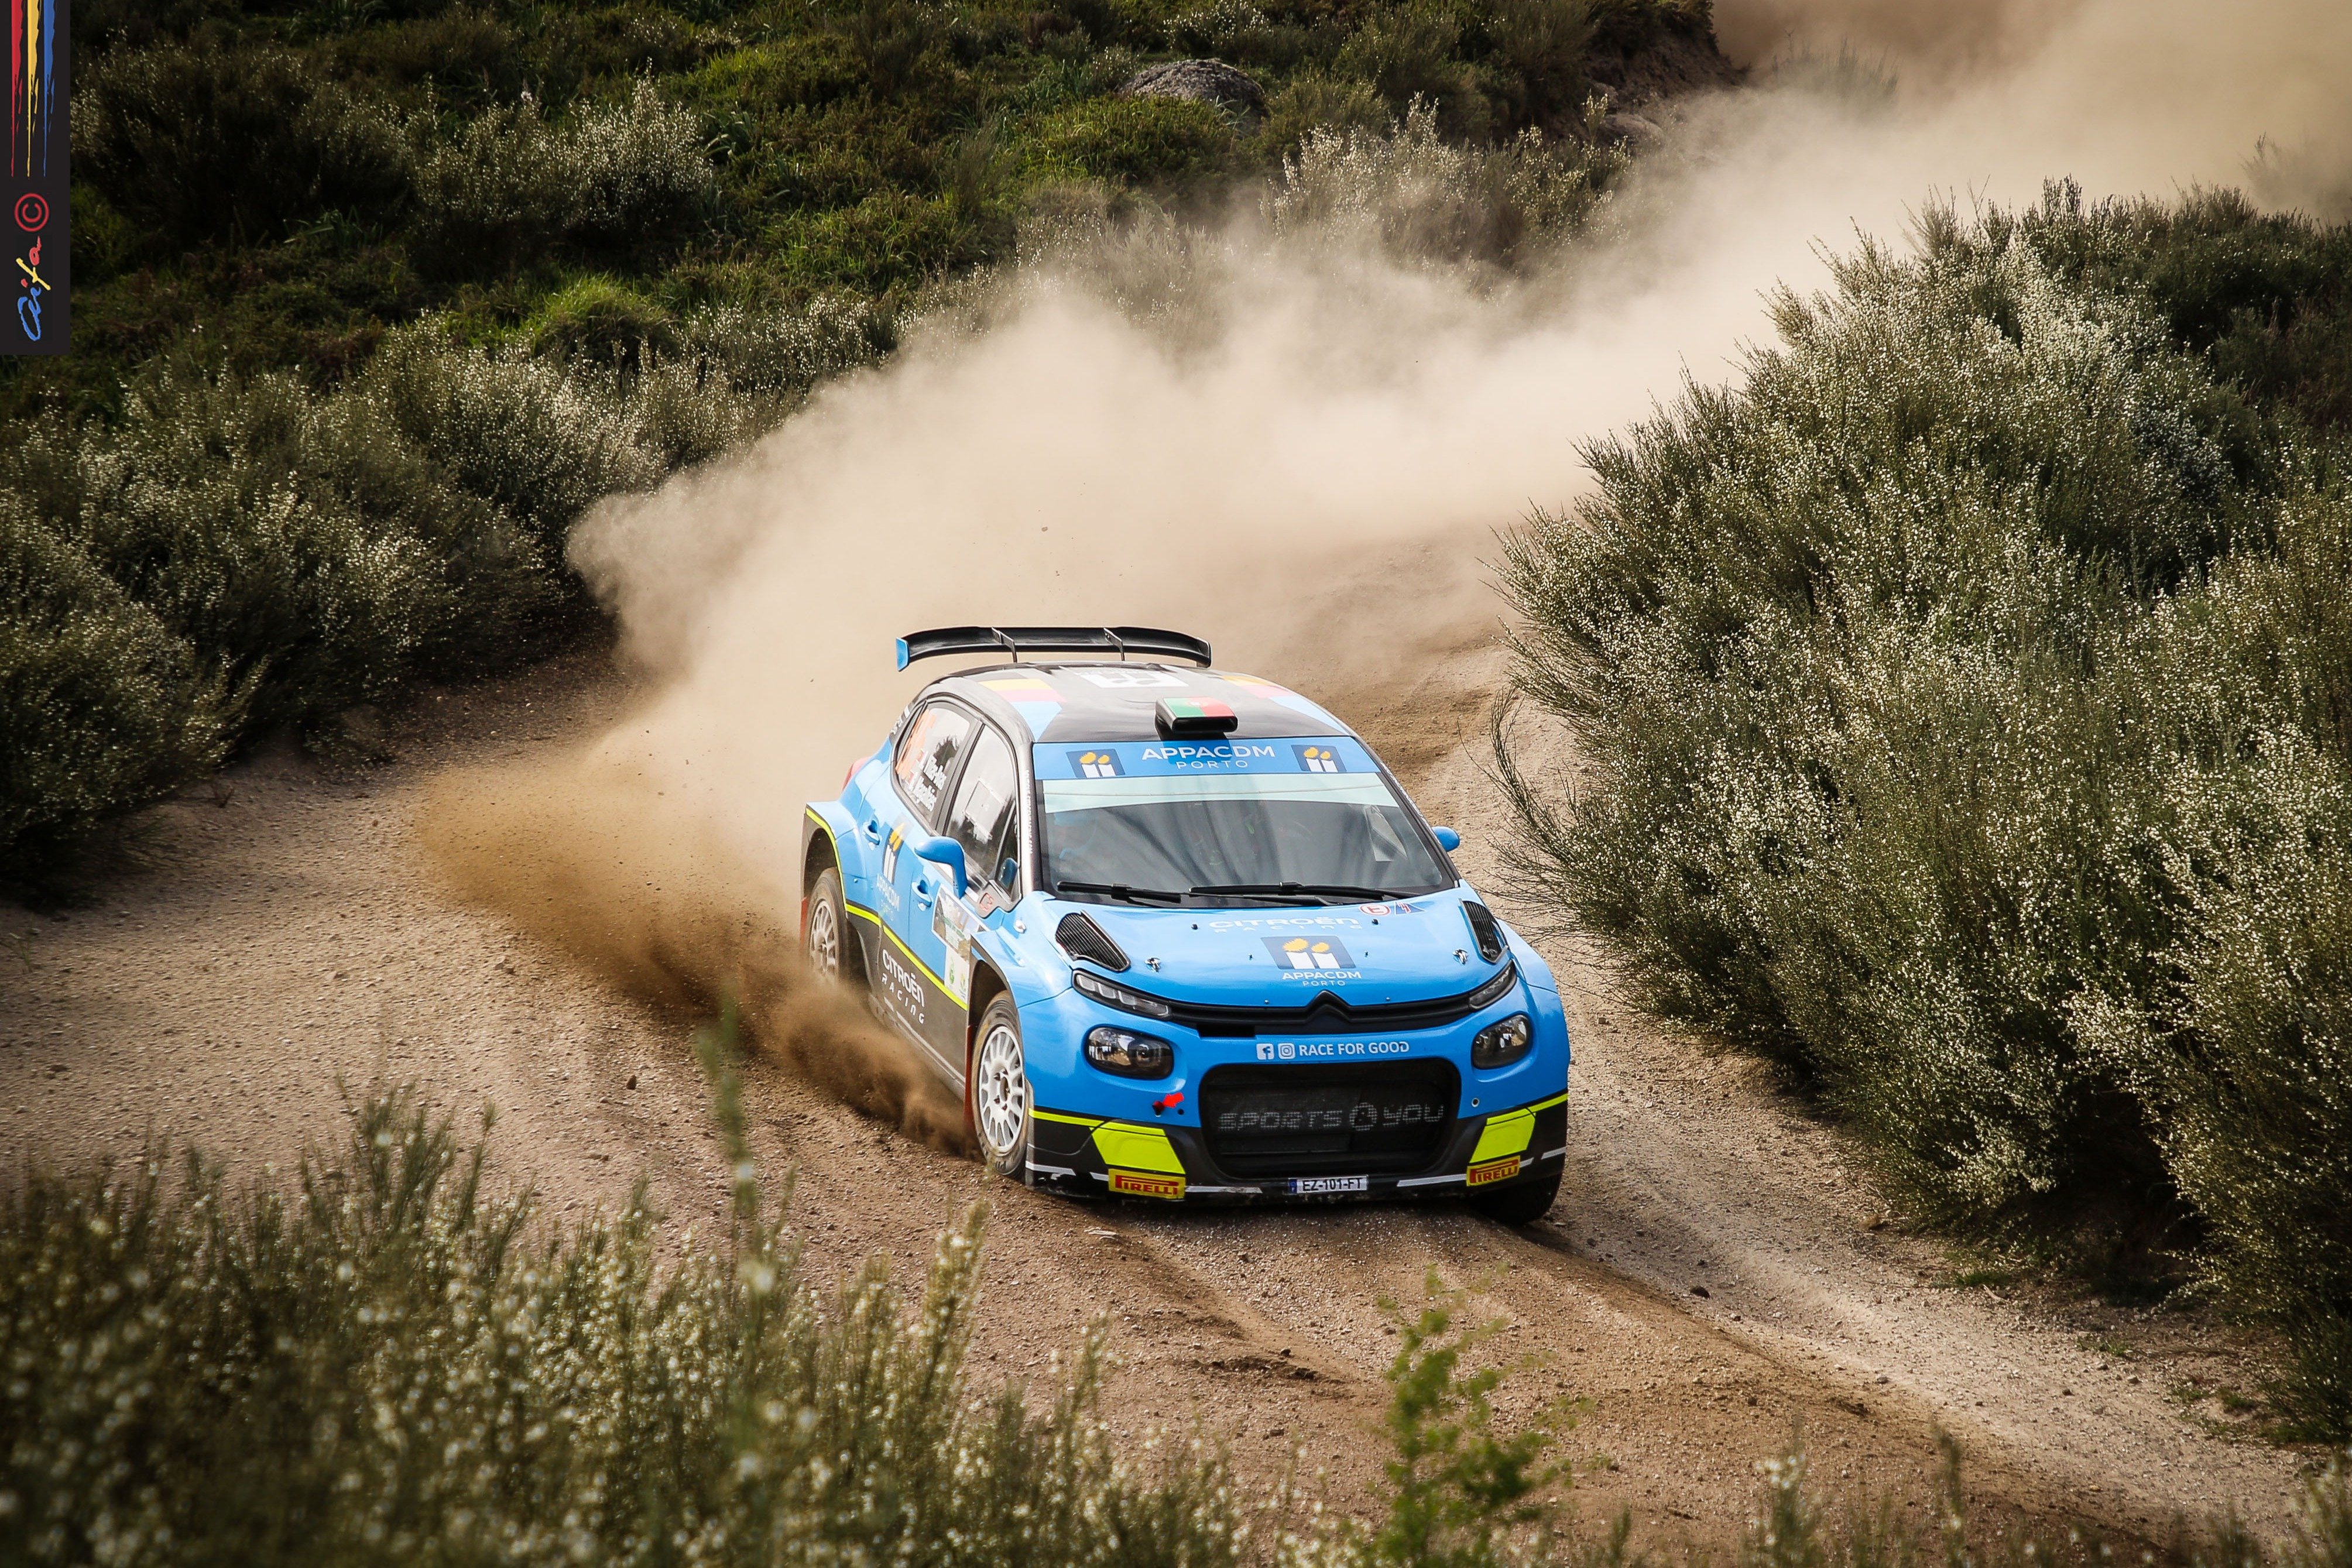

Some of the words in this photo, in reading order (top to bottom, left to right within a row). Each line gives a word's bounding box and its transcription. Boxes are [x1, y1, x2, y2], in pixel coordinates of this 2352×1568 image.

[1142, 746, 1276, 760] APPACDM
[1176, 760, 1248, 769] PORTO
[1282, 971, 1362, 980] APPACDM
[1298, 1044, 1334, 1056] RACE
[1338, 1044, 1365, 1054] FOR
[1368, 1042, 1410, 1054] GOOD
[1218, 1110, 1343, 1131] SPORTS
[1470, 1159, 1519, 1183] PIRELLI
[1115, 1175, 1180, 1195] PIRELLI
[1302, 1178, 1363, 1191] EZ-101-FT
